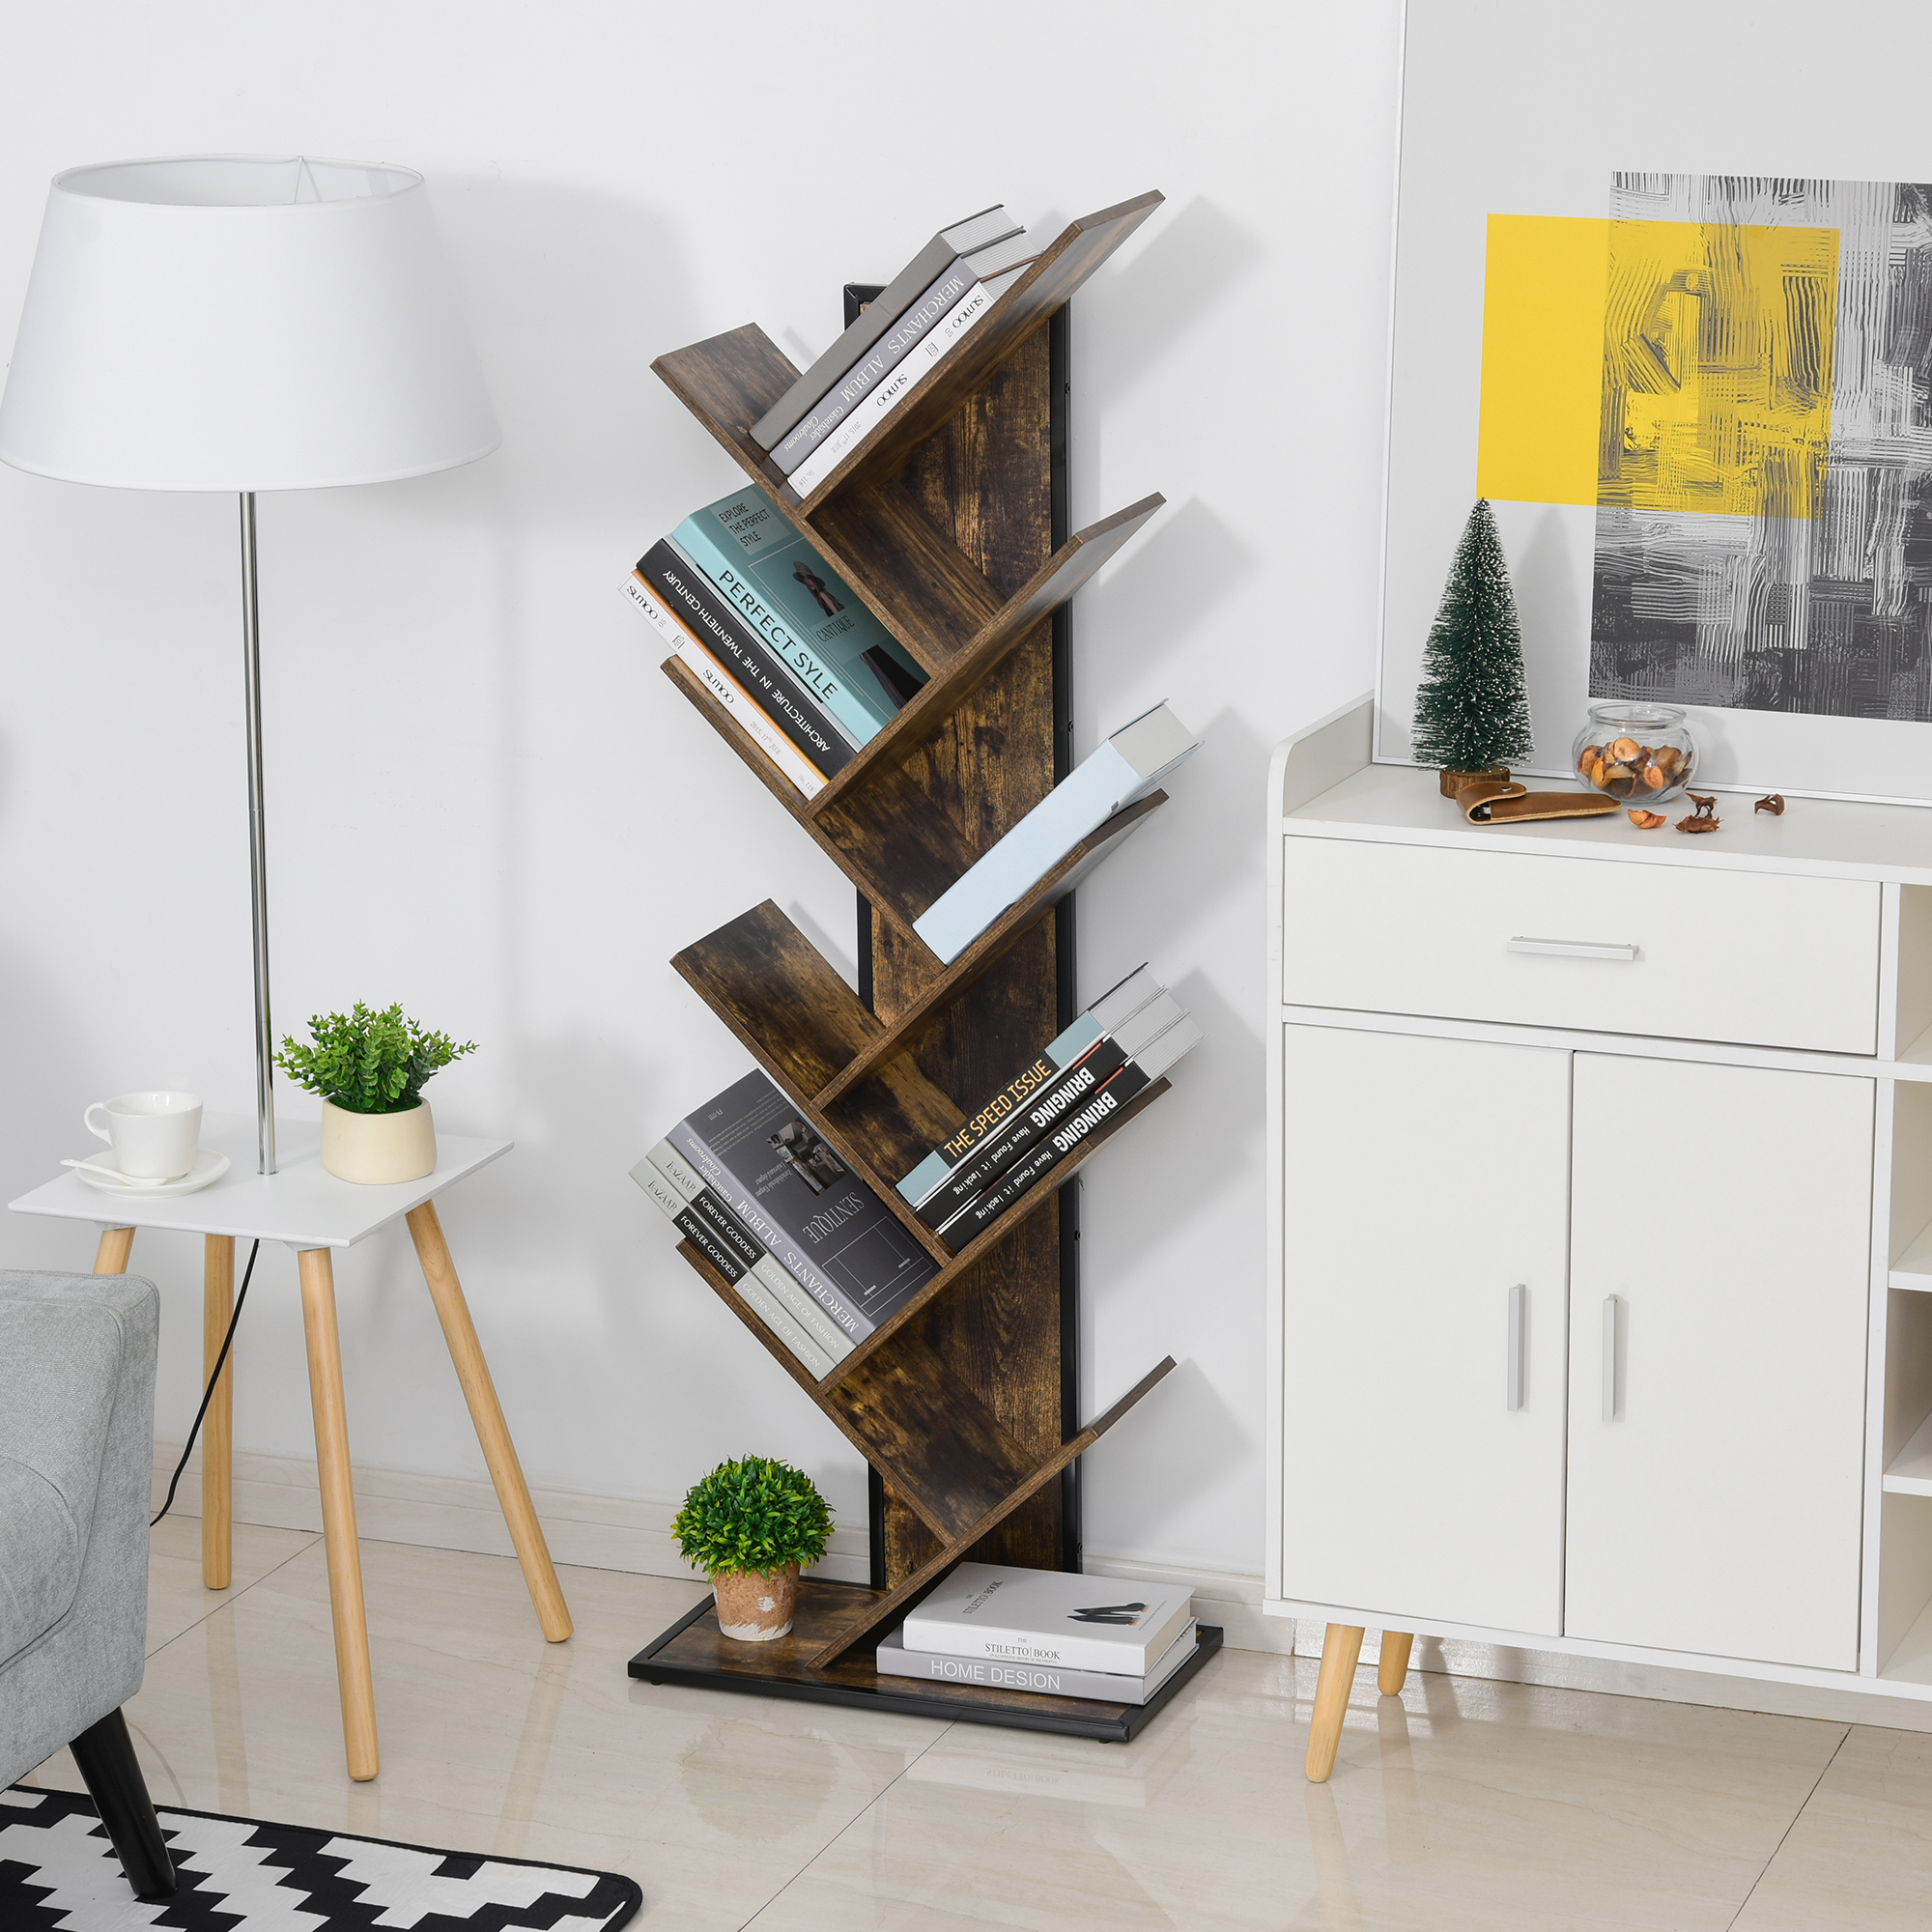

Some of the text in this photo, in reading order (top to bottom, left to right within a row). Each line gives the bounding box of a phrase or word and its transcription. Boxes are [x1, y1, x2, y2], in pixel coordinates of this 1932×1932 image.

[840, 274, 963, 402] MERCHANTS ALBUM
[784, 415, 818, 451] Cloakrooms
[810, 406, 844, 440] Gästebäder
[719, 503, 749, 523] EXPLORE
[729, 509, 770, 534] THE PERFECT
[740, 531, 762, 548] STYLE
[720, 570, 838, 699] PERFECT SYLE
[816, 615, 854, 642] CANTIQUE
[663, 571, 830, 752] ARCHITECTURE IN THE TWENTIETH CENTURY
[944, 1060, 1051, 1158] THE SPEED ISSUE
[953, 1067, 1095, 1195] BRINGING Have Found it lacking
[667, 1160, 696, 1193] BAZAAR
[686, 1138, 721, 1176] Cloakrooms
[975, 1091, 1118, 1220] BRINGING Have Found it lacking
[647, 1180, 677, 1212] BAZAAR
[698, 1165, 732, 1202] Gästebäder
[698, 1196, 757, 1259] FOREVER GODDESS
[736, 1200, 781, 1246] ALBUM
[803, 1192, 865, 1243] SENTIQUE
[680, 1215, 738, 1278] FOREVER GODDESS
[761, 1264, 838, 1349] GOLDEN AGE OF FASHION
[783, 1252, 859, 1332] MERCHANTS
[742, 1283, 820, 1367] GOLDEN AGE OF FASHION
[931, 1661, 984, 1680] HOME
